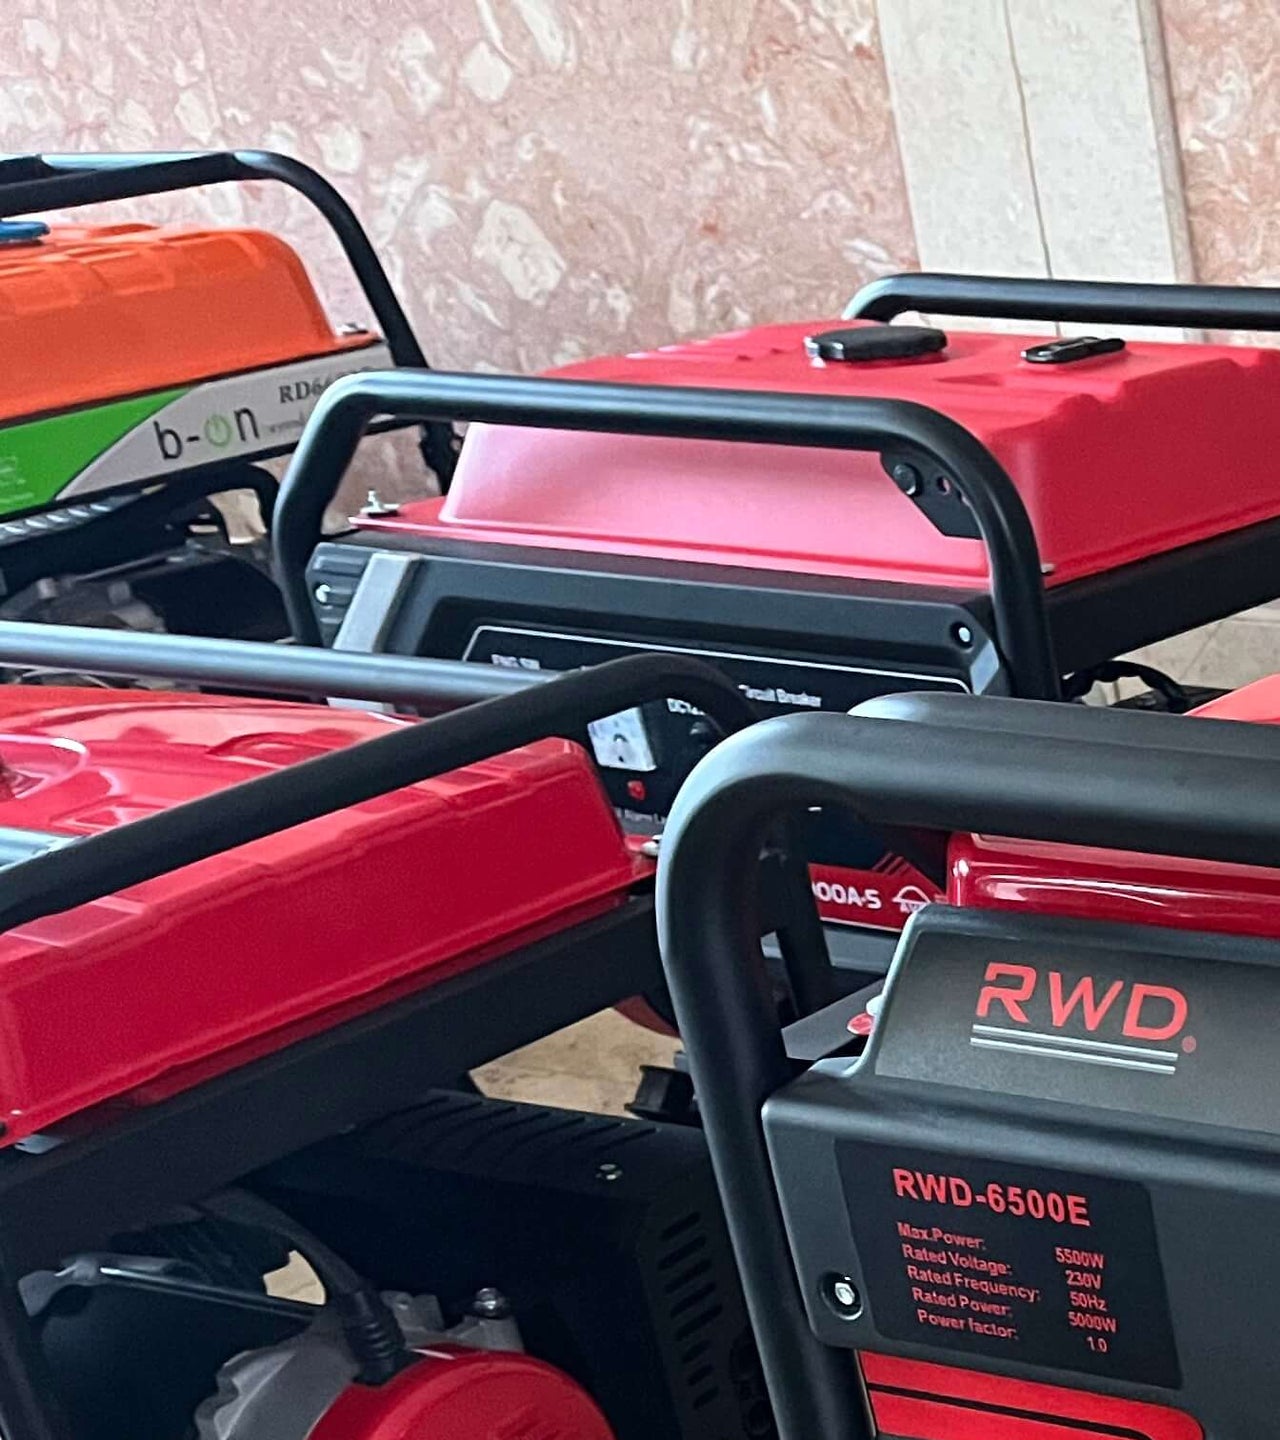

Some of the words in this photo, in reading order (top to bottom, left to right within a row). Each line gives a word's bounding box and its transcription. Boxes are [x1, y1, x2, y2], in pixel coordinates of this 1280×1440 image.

[976, 961, 1188, 1041] RWD
[893, 1168, 1090, 1227] RWD-6500E
[902, 1243, 947, 1265] Rated
[949, 1252, 1013, 1276] Voltage:
[1055, 1247, 1104, 1270] 5500W
[907, 1264, 952, 1286] Rated
[953, 1273, 1041, 1303] Frequency:
[1065, 1270, 1103, 1290] 230V
[912, 1286, 957, 1308] Rated
[959, 1296, 1013, 1318] Power:
[1070, 1292, 1108, 1312] 50Hz
[917, 1309, 966, 1332] Power
[1068, 1311, 1117, 1334] 5000W
[1087, 1336, 1108, 1353] 1.0
